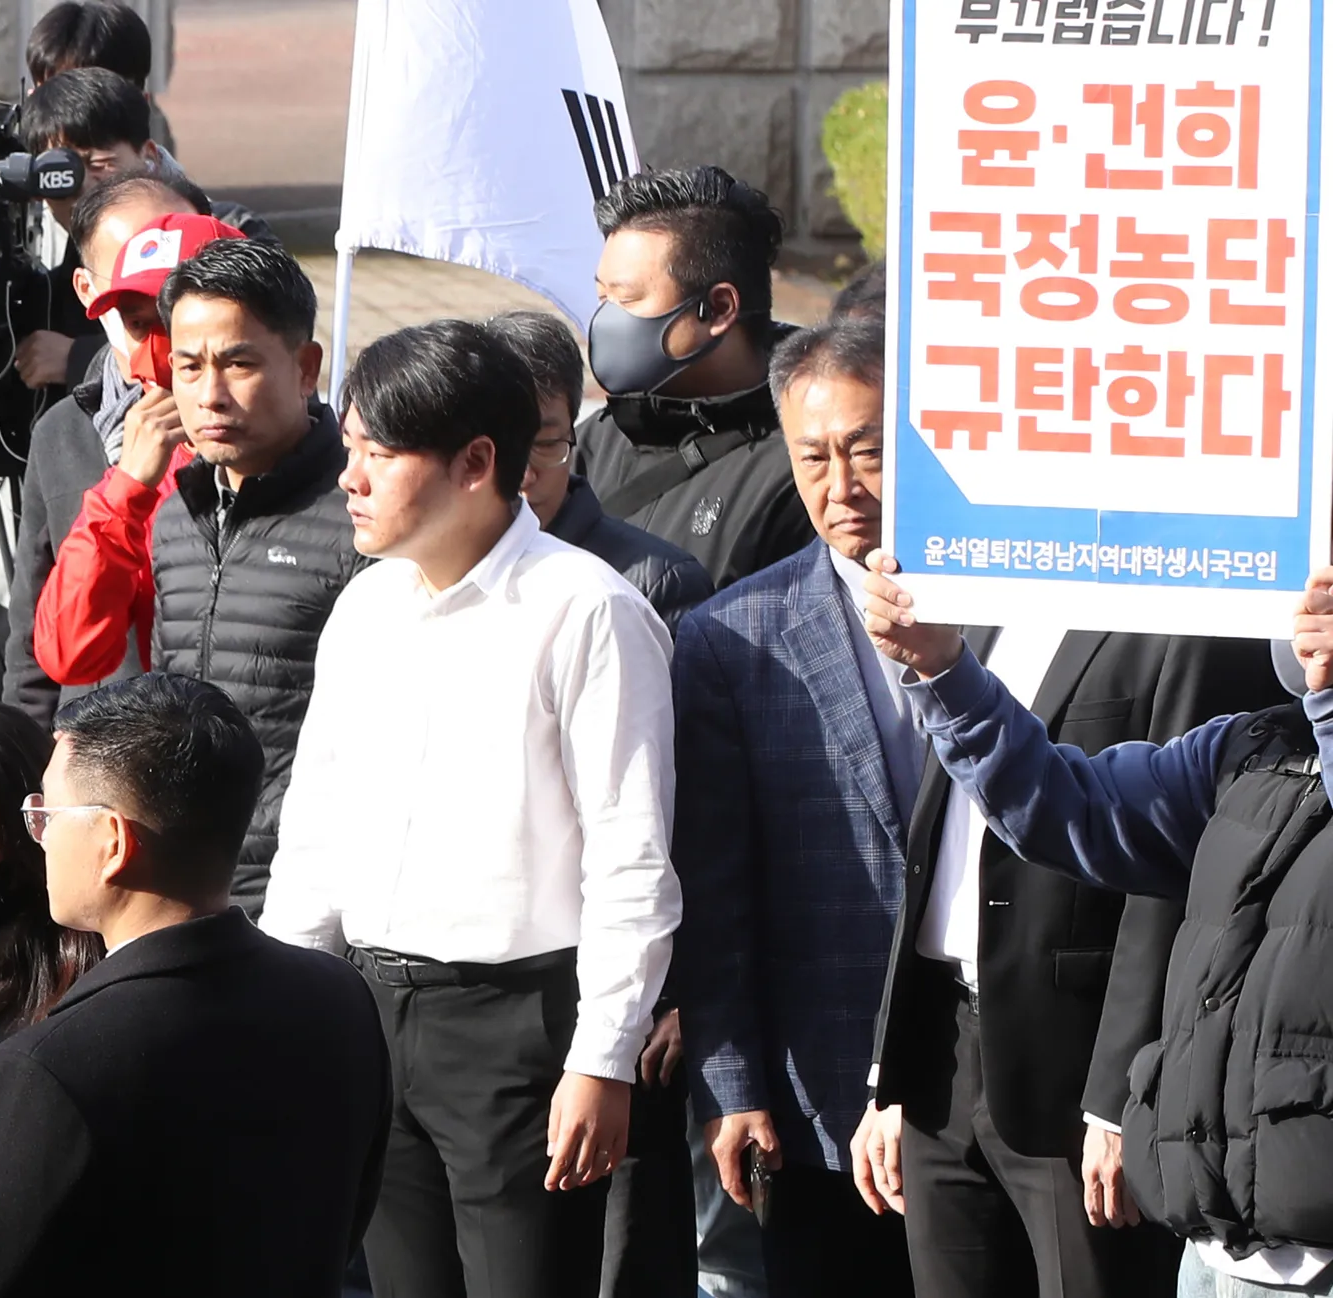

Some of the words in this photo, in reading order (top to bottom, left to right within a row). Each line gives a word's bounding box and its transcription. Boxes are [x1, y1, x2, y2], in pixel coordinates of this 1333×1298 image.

[39, 170, 75, 189] KBS
[958, 80, 1261, 190] 윤·건희
[923, 211, 1296, 326] 국정농단
[920, 345, 1292, 459] 규탄한다
[923, 535, 1278, 582] 윤석열퇴진경남지역대학생시국모임
